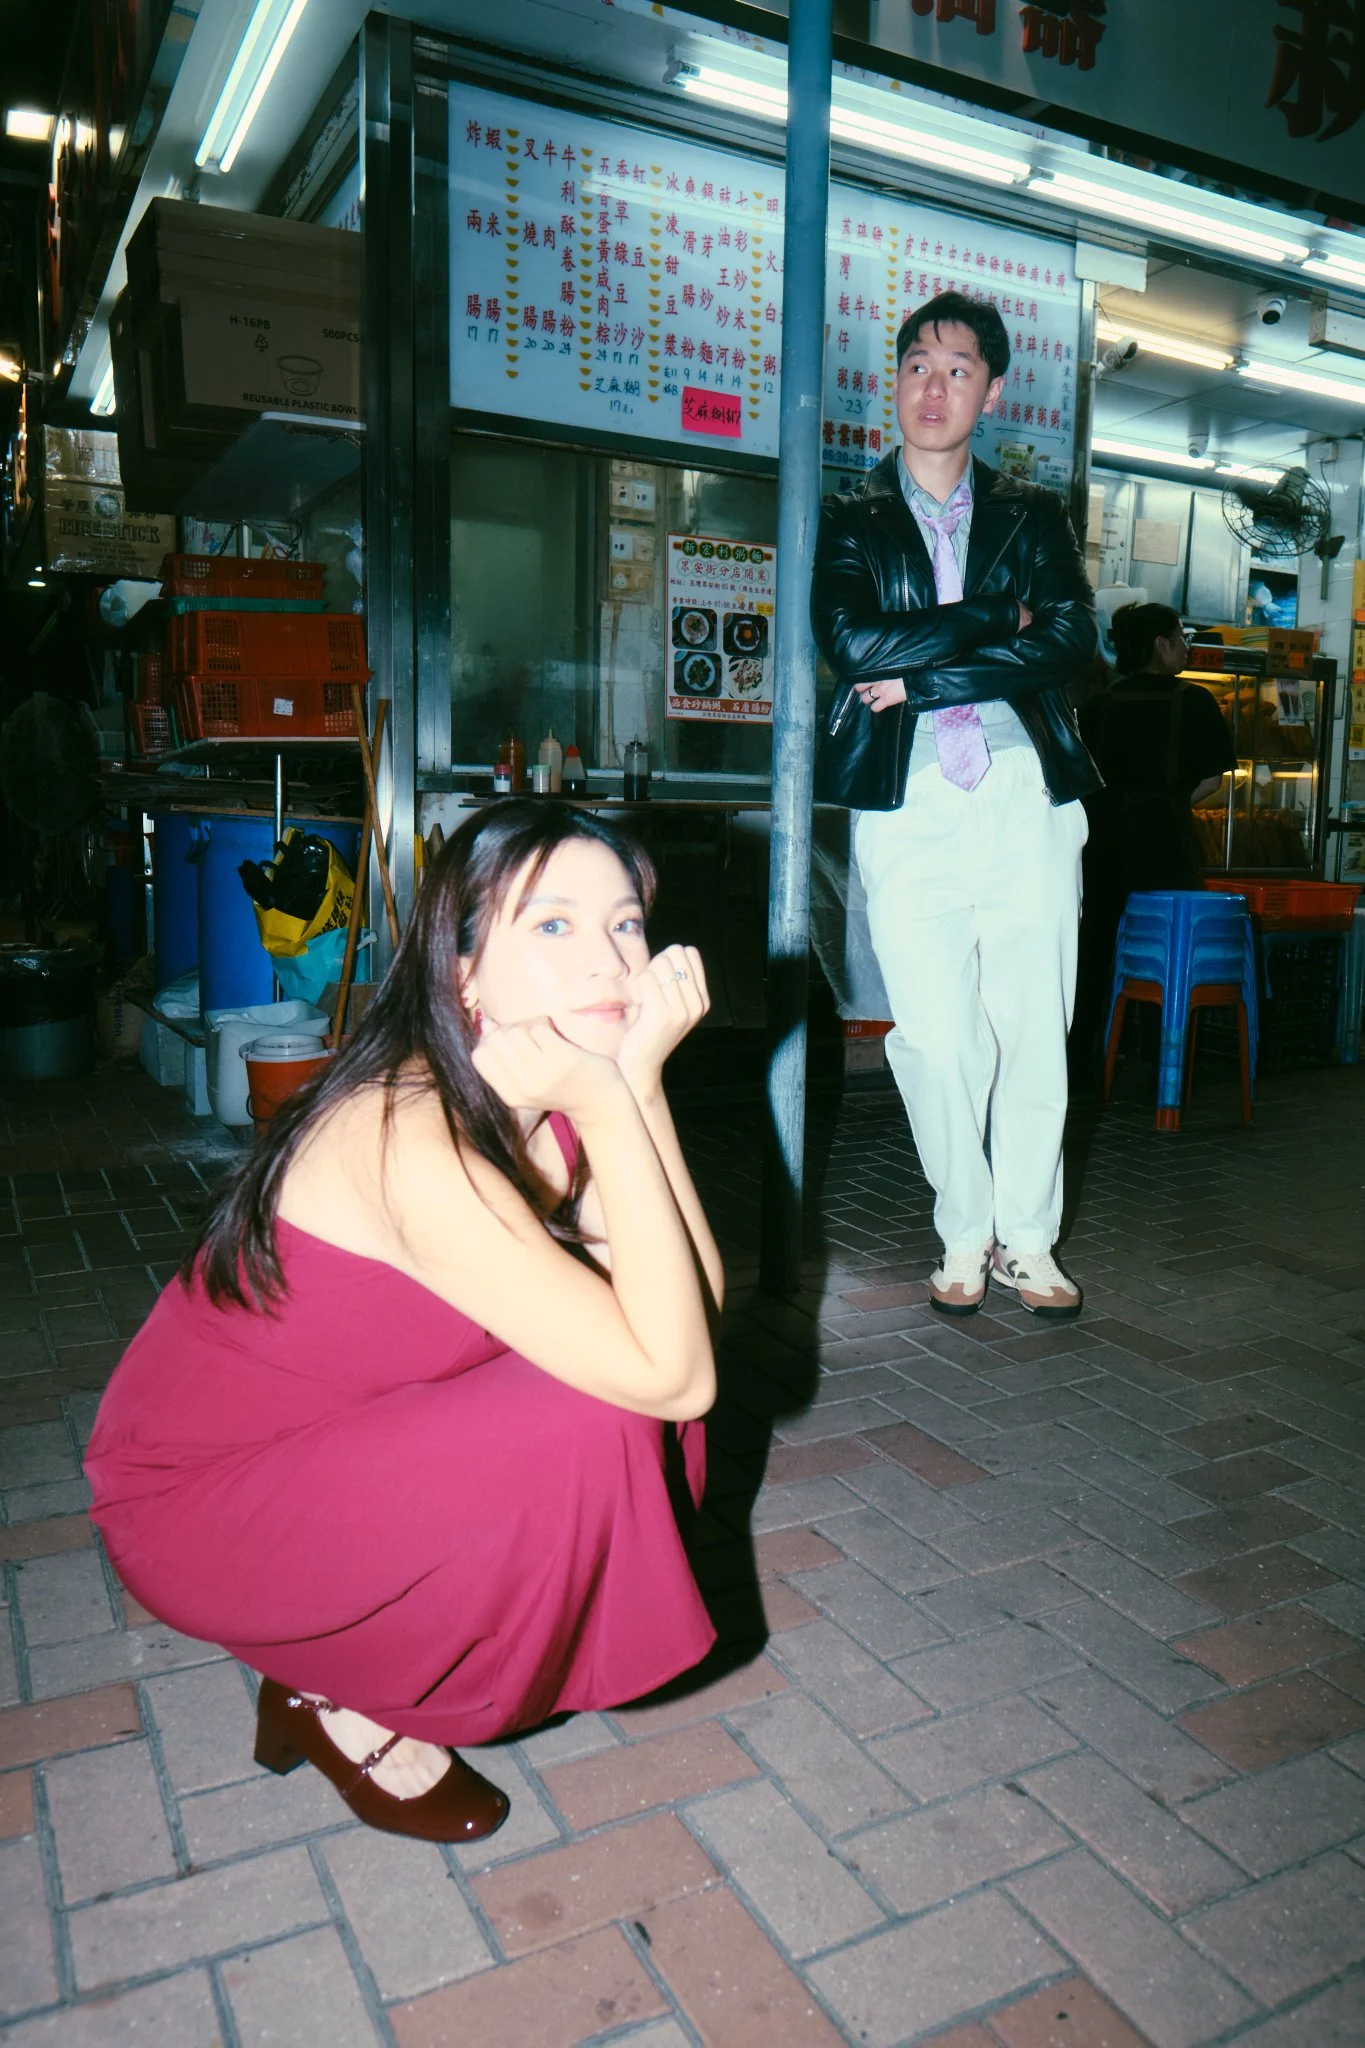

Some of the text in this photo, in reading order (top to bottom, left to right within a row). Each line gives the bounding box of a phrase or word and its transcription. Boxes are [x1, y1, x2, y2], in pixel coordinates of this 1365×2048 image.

[466, 120, 482, 320] 炸兩腸
[484, 127, 503, 324] 蝦米腸
[523, 138, 539, 331] 叉燒腸
[541, 139, 557, 335] 牛肉腸
[524, 336, 538, 350] 20
[542, 338, 556, 352] 20
[683, 367, 691, 381] 9
[764, 381, 775, 394] 12
[242, 392, 290, 406] REUSABLE
[292, 399, 330, 412] PLASTIC
[845, 399, 862, 414] 23
[823, 420, 882, 452] 營業時間
